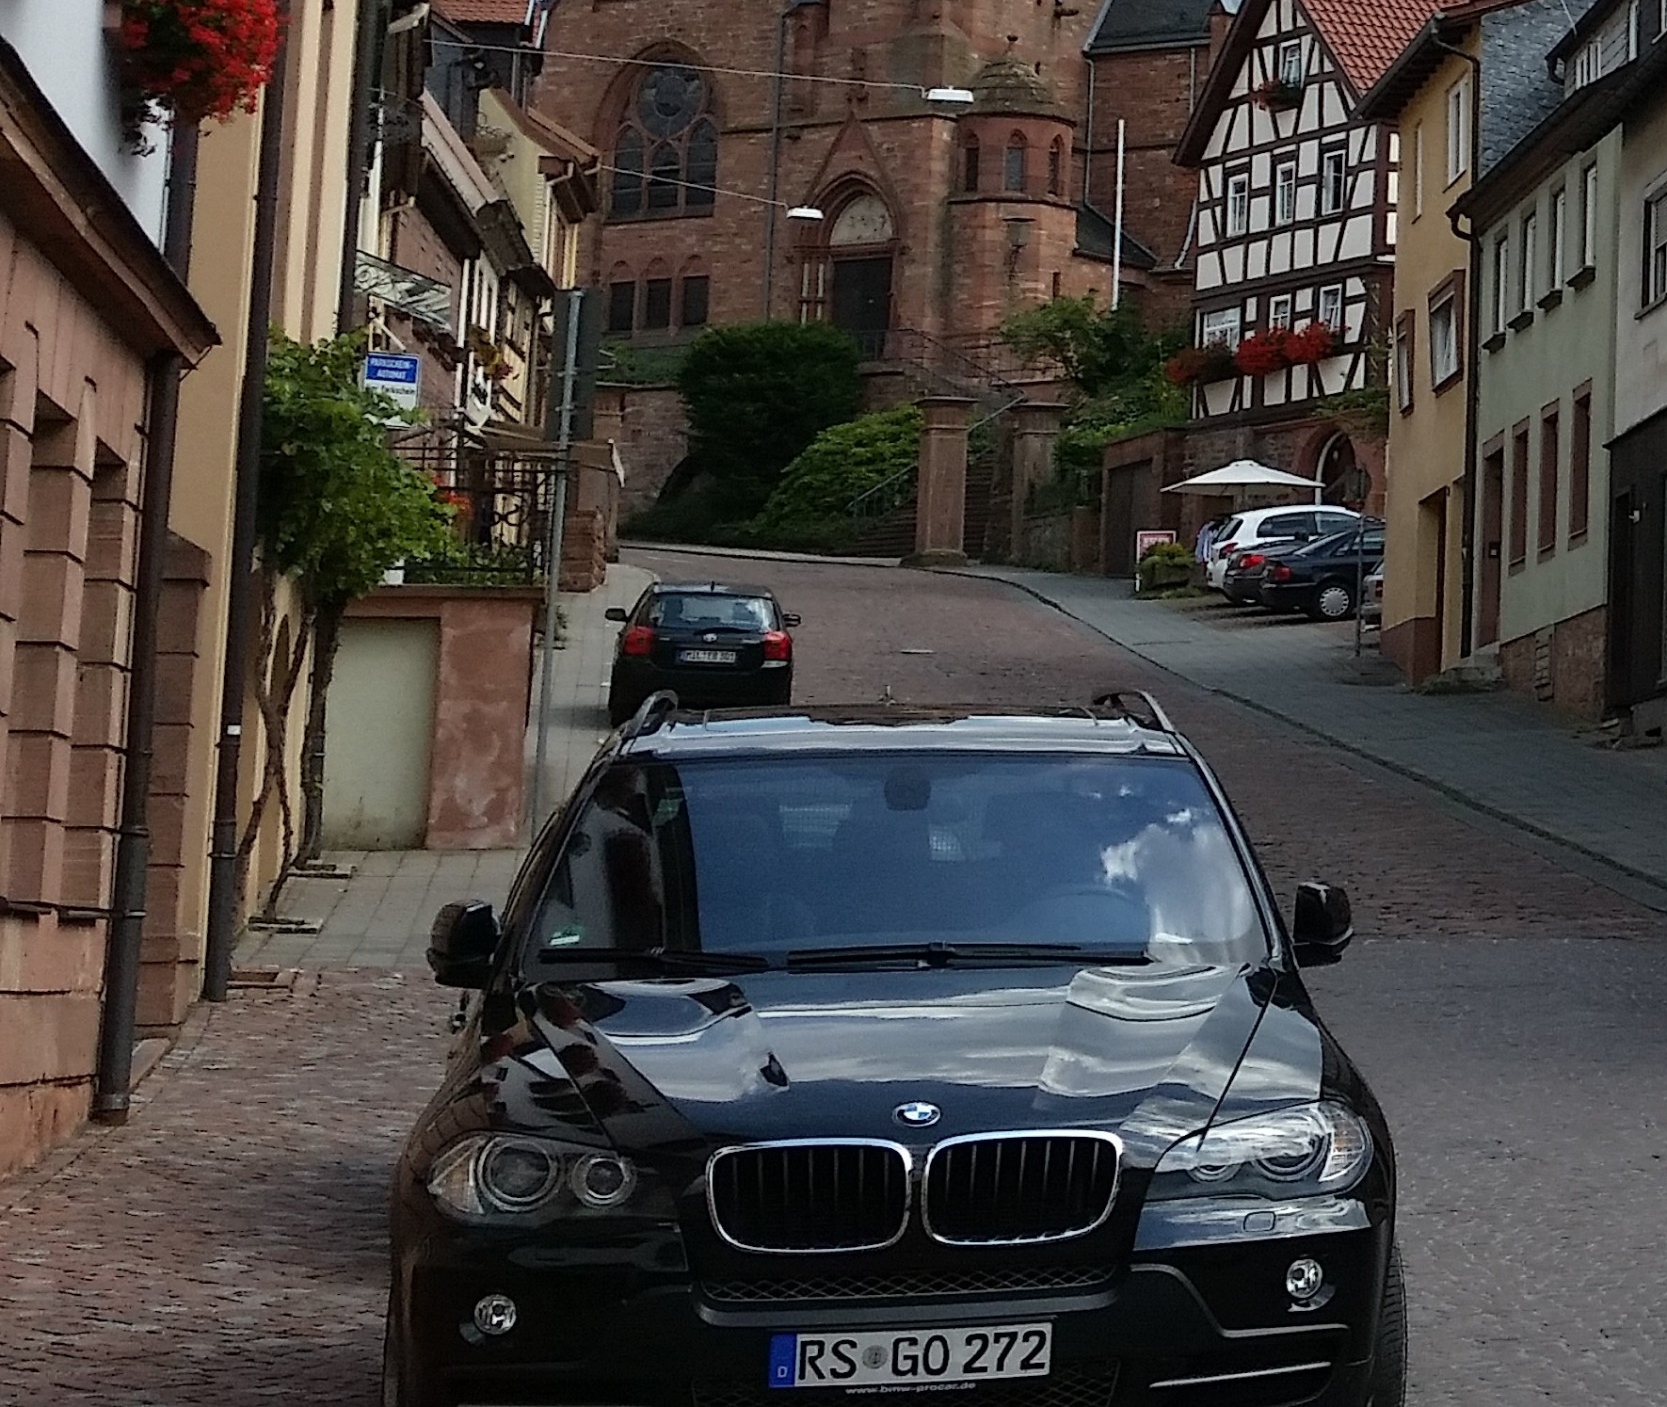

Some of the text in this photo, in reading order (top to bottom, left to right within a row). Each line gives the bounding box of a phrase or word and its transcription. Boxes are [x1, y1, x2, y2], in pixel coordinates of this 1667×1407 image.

[777, 1330, 1048, 1381] D RS GO 272
[845, 1382, 977, 1395] www.bmw-procar.de
